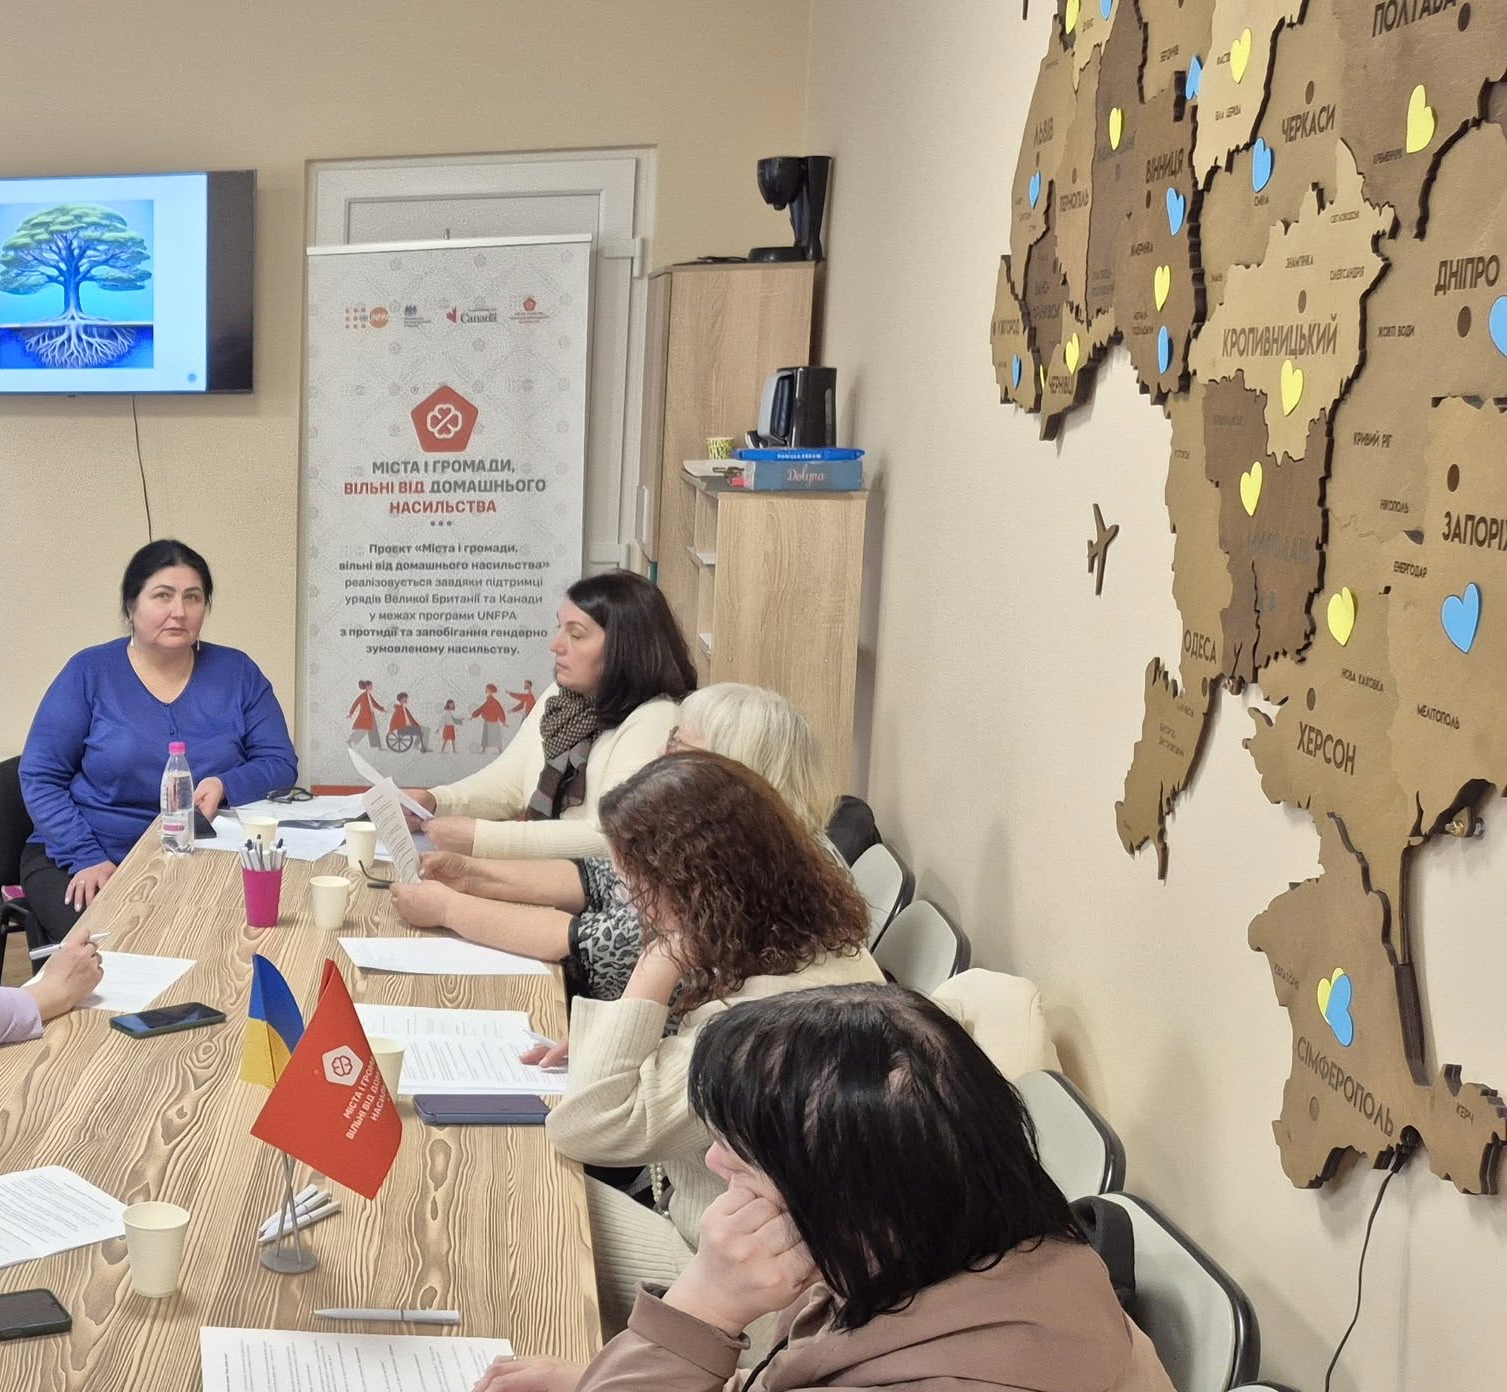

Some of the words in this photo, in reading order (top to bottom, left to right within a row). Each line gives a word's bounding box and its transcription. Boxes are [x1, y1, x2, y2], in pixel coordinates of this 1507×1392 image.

[1282, 104, 1336, 142] ЧЕРКАСИ
[1146, 148, 1184, 184] ВІННИЦЯ
[1434, 254, 1500, 296] ДНІПРО
[1222, 313, 1339, 359] КРОПИВНИЦЬКИЙ
[1353, 430, 1380, 448] КРИВИЙ
[372, 461, 421, 474] МІСТА
[424, 461, 429, 474] І
[432, 459, 515, 474] ГРОМАДИ,
[344, 481, 394, 495] ВІЛЬНІ
[398, 481, 425, 494] ВІД
[428, 479, 546, 494] ДОМАШНЬОГО
[389, 500, 497, 514] НАСИЛЬСТВА
[1379, 499, 1409, 514] НІКОПОЛЬ
[369, 543, 412, 554] Проєкт
[414, 543, 455, 554] «Міста
[464, 544, 518, 555] громади,
[339, 560, 373, 570] вільні
[375, 560, 393, 572] від
[395, 561, 469, 572] домашнього
[471, 561, 550, 570] насильства»
[1393, 561, 1428, 578] ЕНЕРГОДАР
[344, 577, 432, 589] реалізовується
[435, 578, 483, 588] завдяки
[485, 577, 543, 588] підтримці
[344, 594, 382, 606] урядів
[384, 593, 430, 604] Великої
[431, 593, 480, 604] Британії
[483, 595, 496, 604] та
[498, 594, 543, 605] Канади
[369, 612, 376, 622] у
[378, 612, 416, 621] межах
[418, 612, 475, 623] програми
[477, 610, 517, 621] UNFPA
[340, 628, 346, 637] з
[348, 627, 398, 638] протидії
[400, 629, 413, 637] та
[415, 627, 488, 638] запобігання
[490, 628, 548, 639] гендерно
[366, 645, 445, 656] зумовленому
[447, 645, 520, 656] насильству.
[1183, 629, 1217, 664] ОДЕСА
[1416, 704, 1460, 730] МЕЛІТОПОЛЬ
[1297, 721, 1357, 776] ХЕРСОН
[1296, 1035, 1394, 1138] СІМФЕРОПОЛЬ
[342, 1089, 364, 1119] МІСТА
[345, 1109, 367, 1140] ВІЛЬНІ
[361, 1094, 375, 1111] ВІД
[370, 1070, 381, 1094] ДОМ
[1456, 1102, 1475, 1126] КЕРЧ
